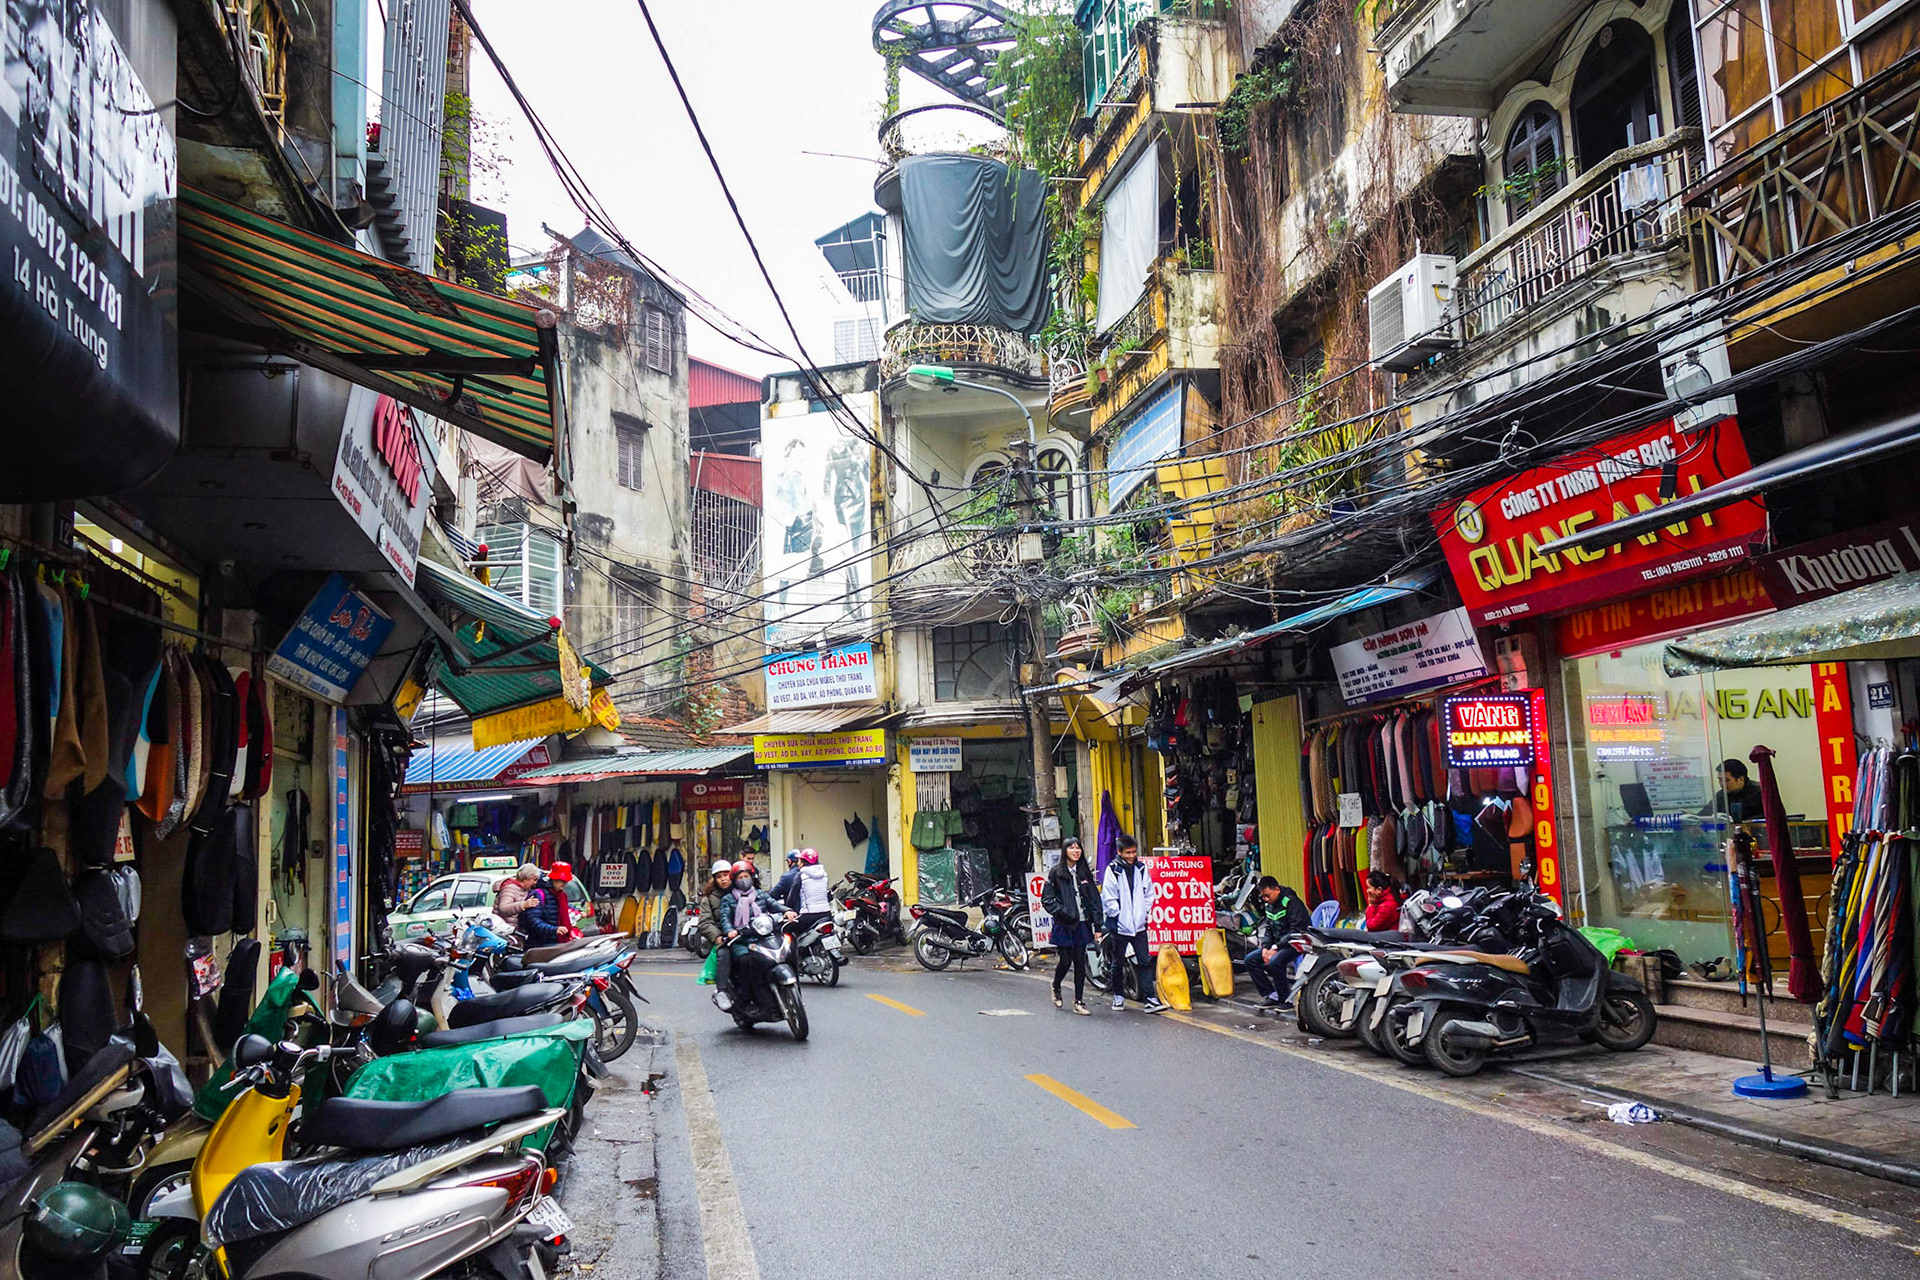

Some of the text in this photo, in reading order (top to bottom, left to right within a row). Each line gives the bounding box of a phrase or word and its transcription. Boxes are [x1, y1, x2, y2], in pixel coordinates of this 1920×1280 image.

[27, 191, 67, 272] 0912
[70, 241, 96, 302] 121
[99, 270, 122, 331] 781
[13, 244, 108, 371] 14 Hà Trung
[1500, 490, 1537, 521] CÔNG
[1535, 481, 1558, 508] TY
[1556, 464, 1599, 500] TNHH
[1468, 508, 1605, 593] QUANG
[1708, 548, 1728, 565] 3826
[1729, 545, 1744, 560] 1111
[1777, 537, 1907, 597] Khương
[768, 651, 869, 676] CHUNG THÀNH
[1458, 701, 1521, 728] VÀNG
[817, 737, 837, 746] MODEL
[854, 735, 873, 744] TRANG
[1451, 731, 1499, 746] QUANG
[1499, 731, 1531, 745] ANH
[1463, 748, 1520, 760] 21 HÀ TRUNG
[1635, 813, 1683, 832] WELCOME
[1156, 858, 1170, 869] HÀ
[1172, 860, 1204, 869] TRUNG
[1160, 868, 1190, 878] CHUYÊN
[1031, 879, 1046, 896] 17
[1151, 878, 1213, 902] ỌC YÊN
[1178, 900, 1215, 924] GHẾ
[1159, 927, 1192, 942] TÚI THAY
